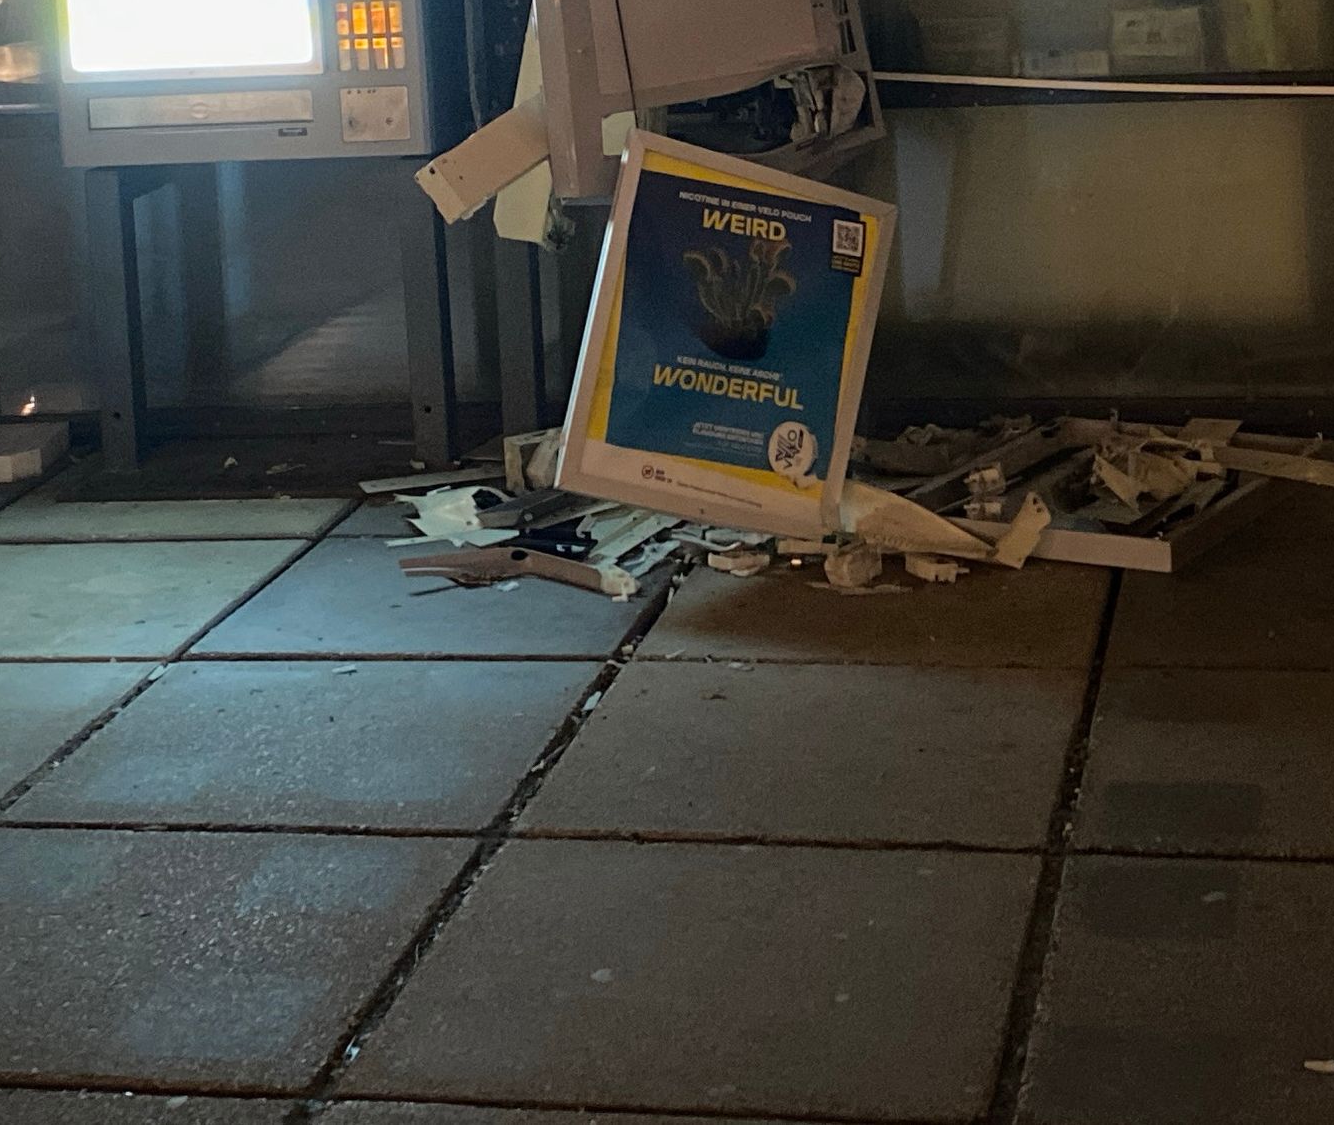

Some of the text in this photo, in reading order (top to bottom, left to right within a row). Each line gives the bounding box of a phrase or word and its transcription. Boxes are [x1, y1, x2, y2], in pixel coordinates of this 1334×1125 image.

[679, 191, 720, 206] NICOTINE
[758, 205, 780, 217] VELO
[781, 210, 812, 223] POUCH
[702, 207, 787, 242] WEIRD
[653, 363, 805, 411] WONDERFUL
